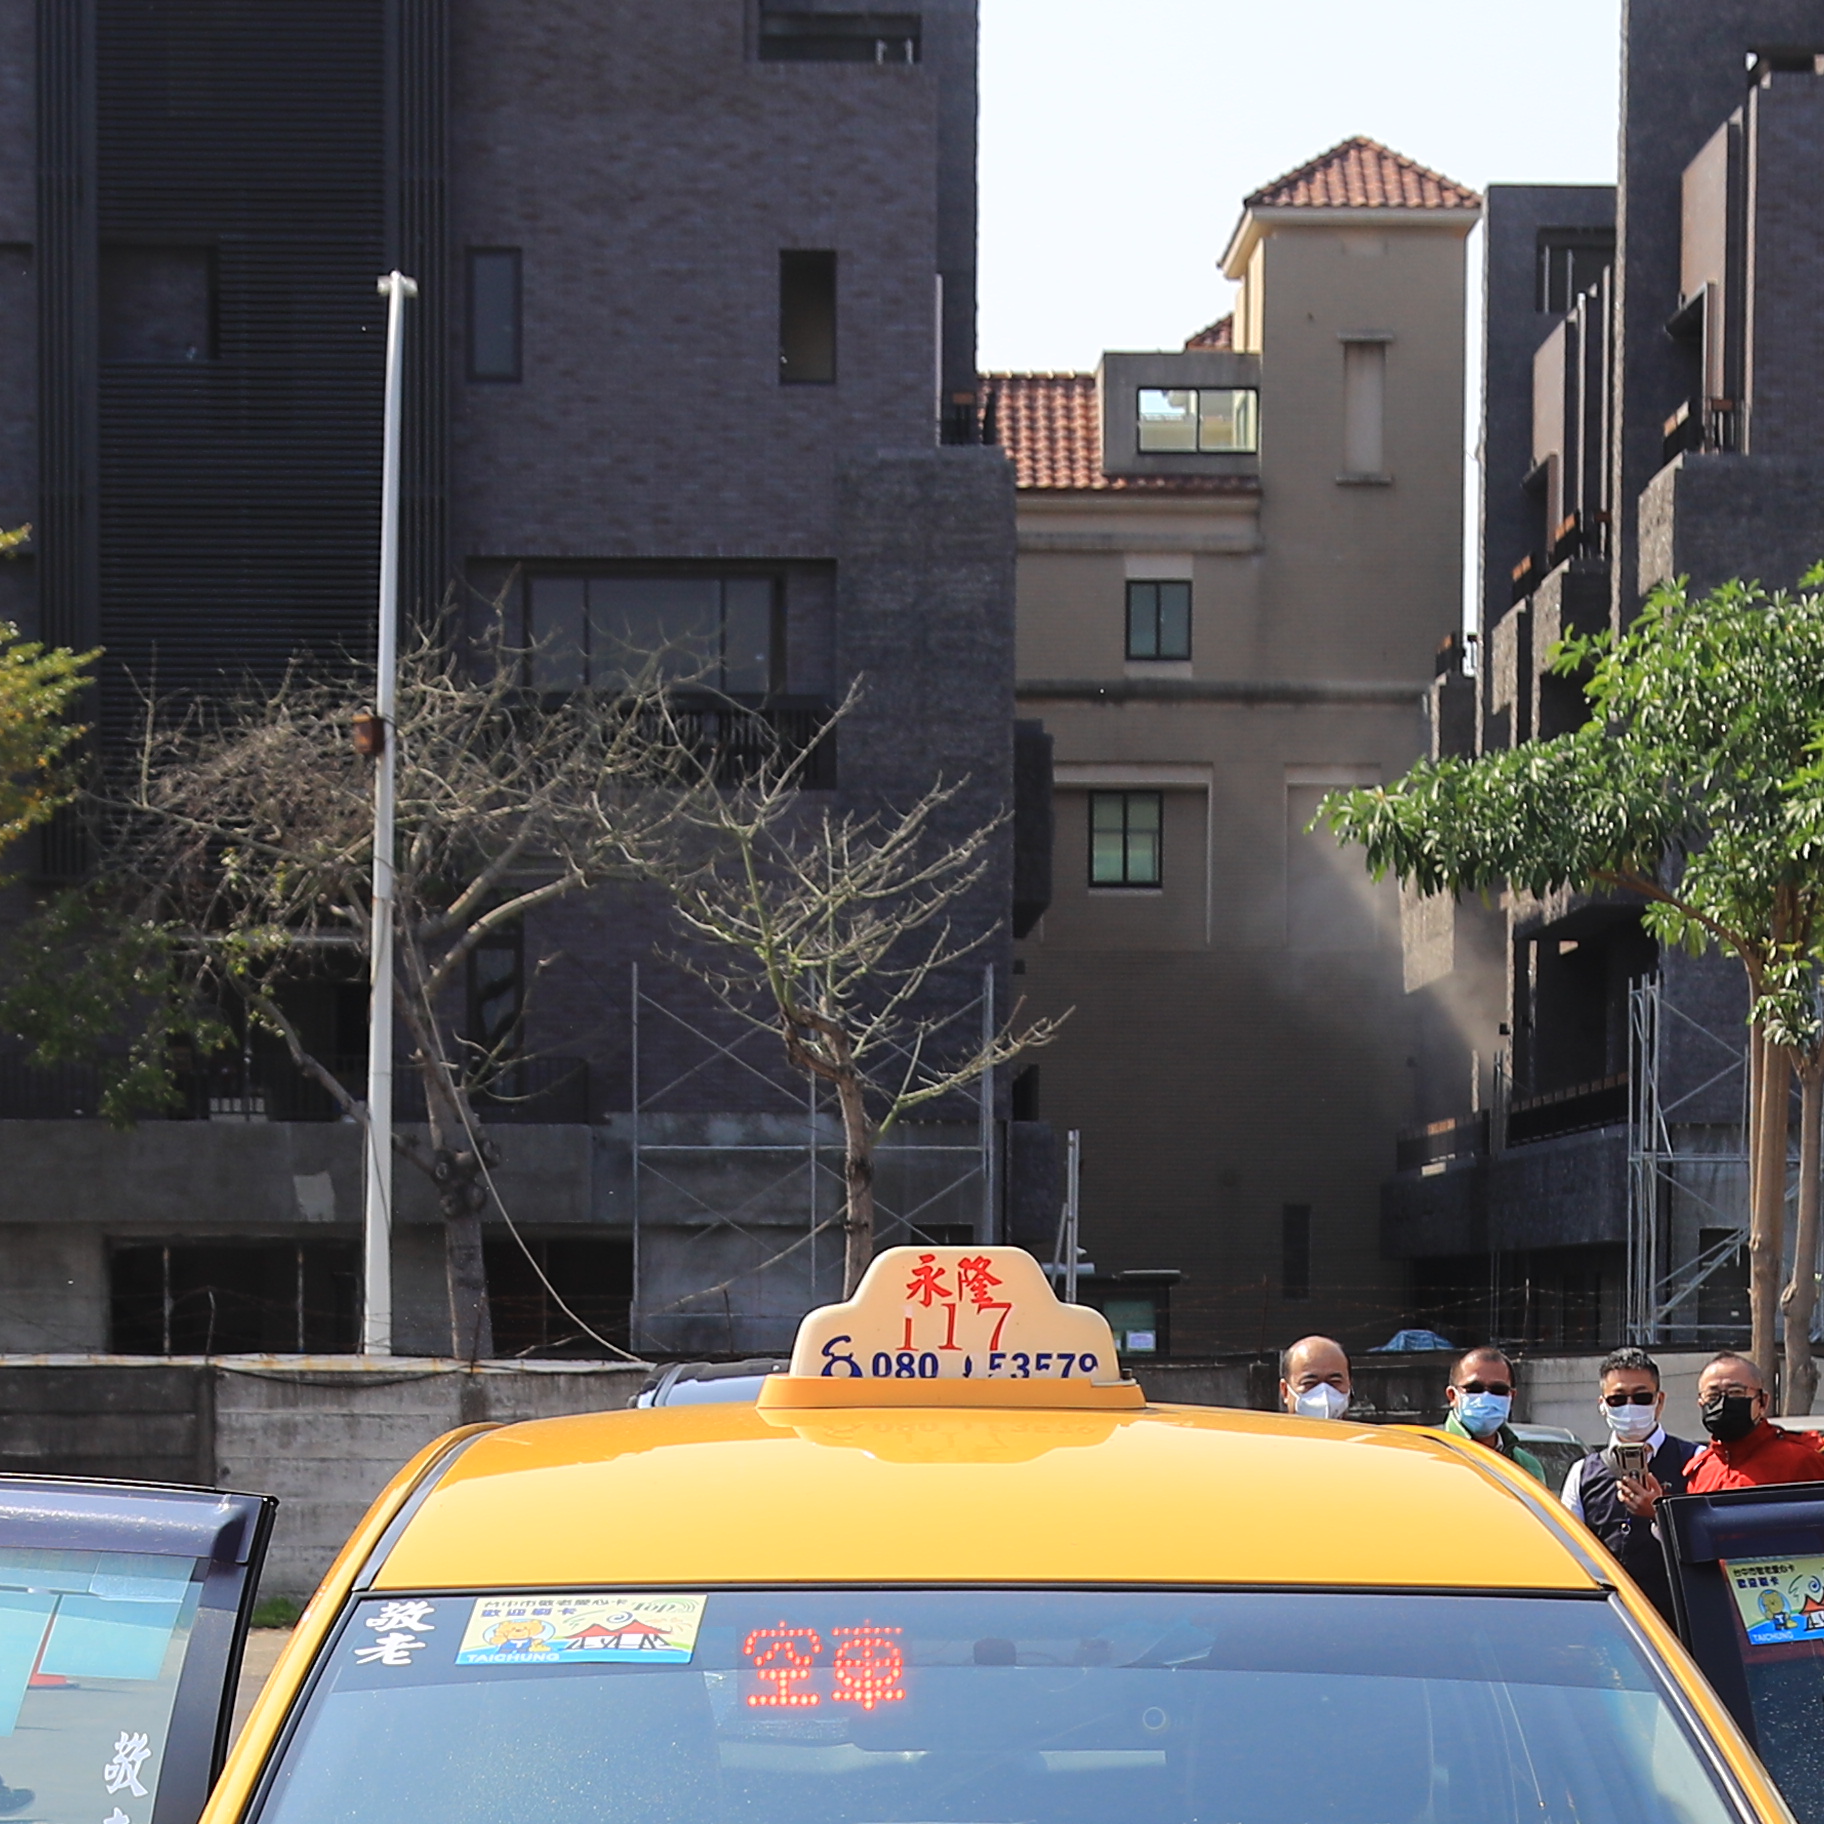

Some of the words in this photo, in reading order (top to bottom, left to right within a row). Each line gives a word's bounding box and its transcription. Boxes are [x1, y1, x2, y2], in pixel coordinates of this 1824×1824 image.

[906, 1254, 1003, 1307] 永隆
[895, 1303, 1014, 1351] 117
[354, 1601, 435, 1665] 敬老
[467, 1653, 560, 1663] TAICHUNG
[1752, 1631, 1794, 1642] TAICHUNG
[743, 1620, 906, 1710] 空車
